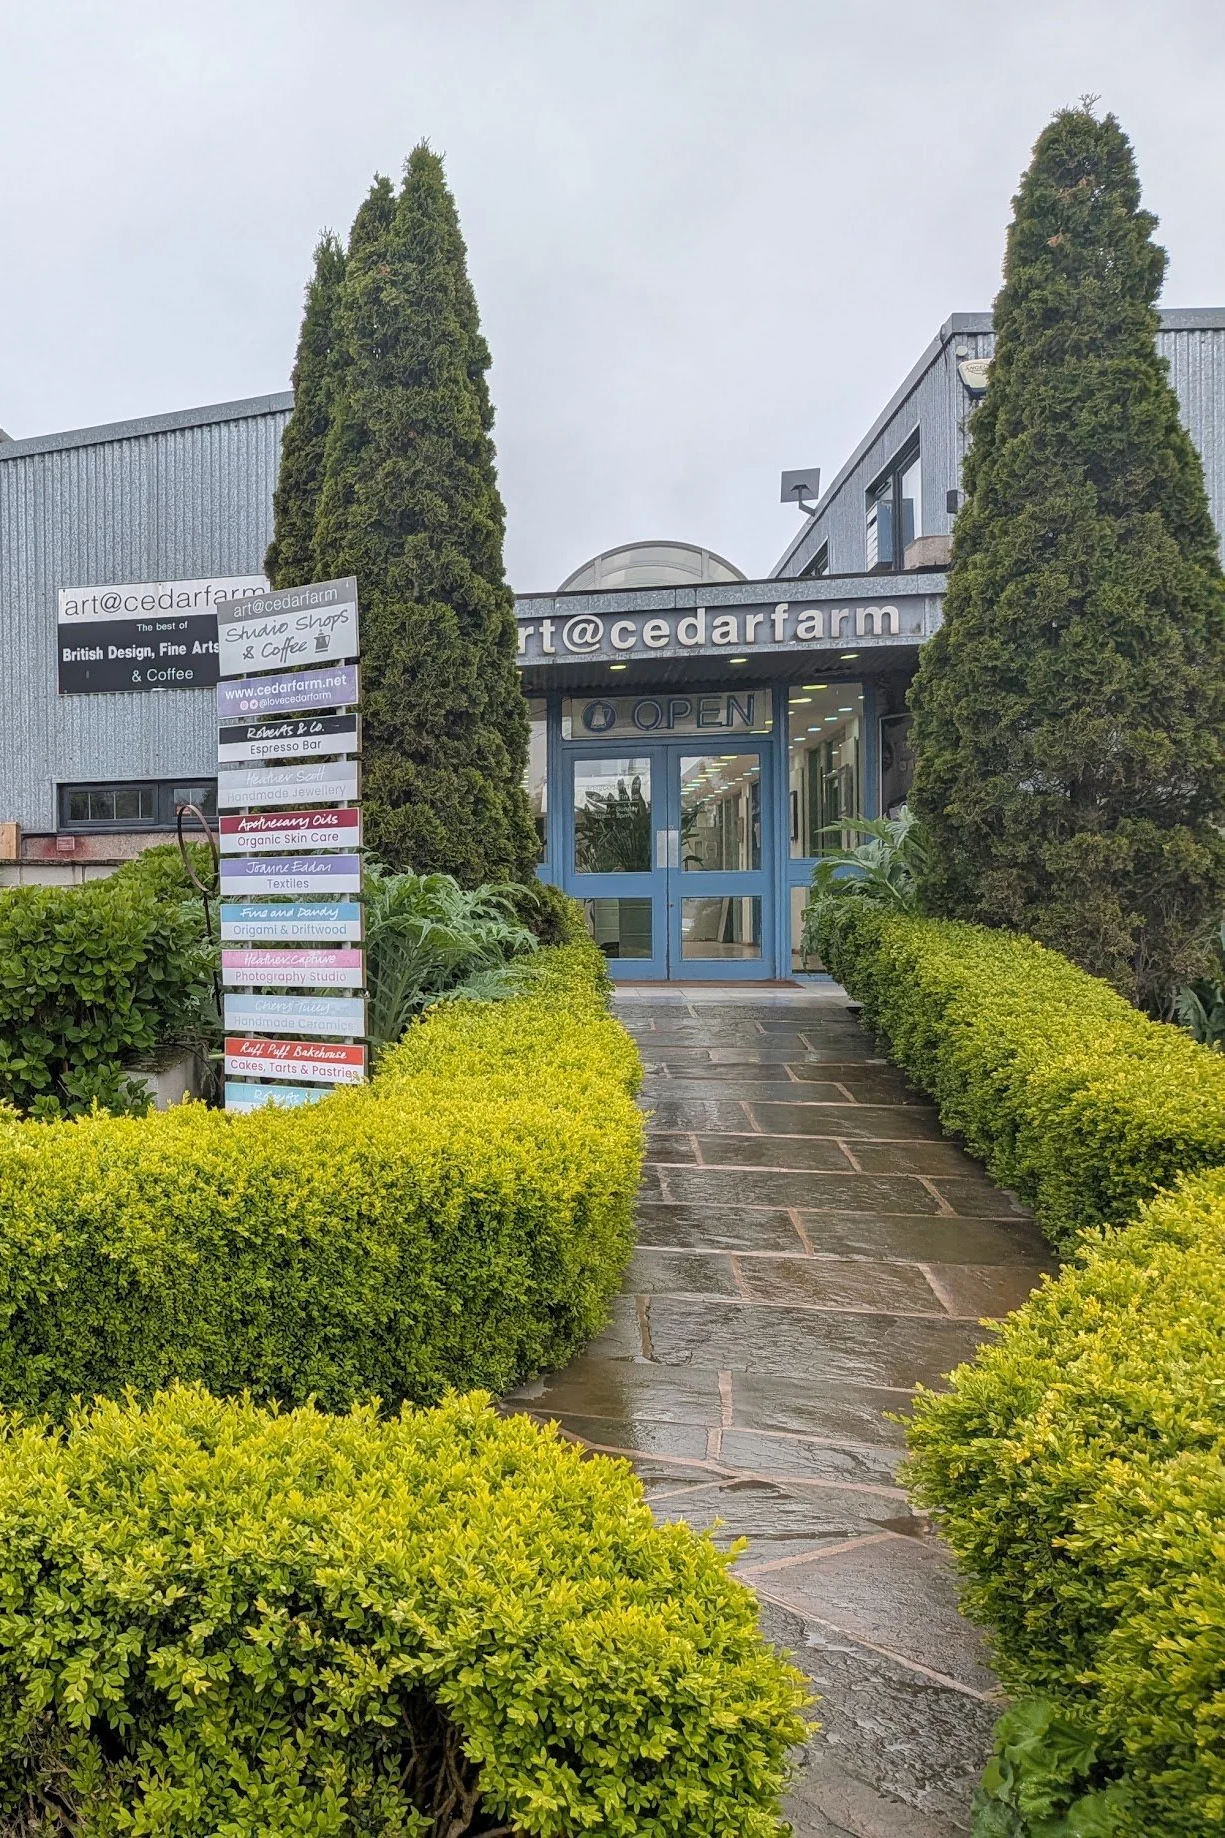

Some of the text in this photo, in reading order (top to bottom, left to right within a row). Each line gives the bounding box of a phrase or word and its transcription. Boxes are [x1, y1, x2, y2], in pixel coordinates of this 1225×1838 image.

[64, 585, 265, 616] art@cedarfarm
[234, 588, 338, 618] art@cedarfarm
[136, 620, 188, 632] The best of
[225, 609, 349, 643] Studio Shops
[517, 603, 900, 654] rt@cedarfarm
[62, 640, 219, 662] British Design, Fine Arts
[242, 636, 308, 664] & Coffee
[131, 667, 194, 683] & Coffee
[225, 673, 347, 700] www.cedarfarm.net
[259, 691, 332, 709] @lovecedarfarm
[634, 693, 755, 731] OPEN
[247, 724, 294, 739] Roberts
[296, 722, 308, 735] &
[250, 740, 322, 756] Espresso Bar
[296, 765, 326, 783] Scott
[227, 784, 346, 803] Handmade Jewellery
[238, 813, 338, 831] Apothecary Oils
[237, 831, 339, 849] Organic Skin Care
[266, 879, 310, 889] Textiles
[240, 906, 339, 920] Fine and Dandy
[233, 924, 347, 938] Origami & Driftwood
[235, 970, 347, 984] Photography Studio
[234, 1016, 353, 1031] Handmade Ceramics
[240, 1042, 348, 1059] Ruff Puff Bakehouse
[230, 1059, 358, 1079] Cakes, Tarts & Pastries
